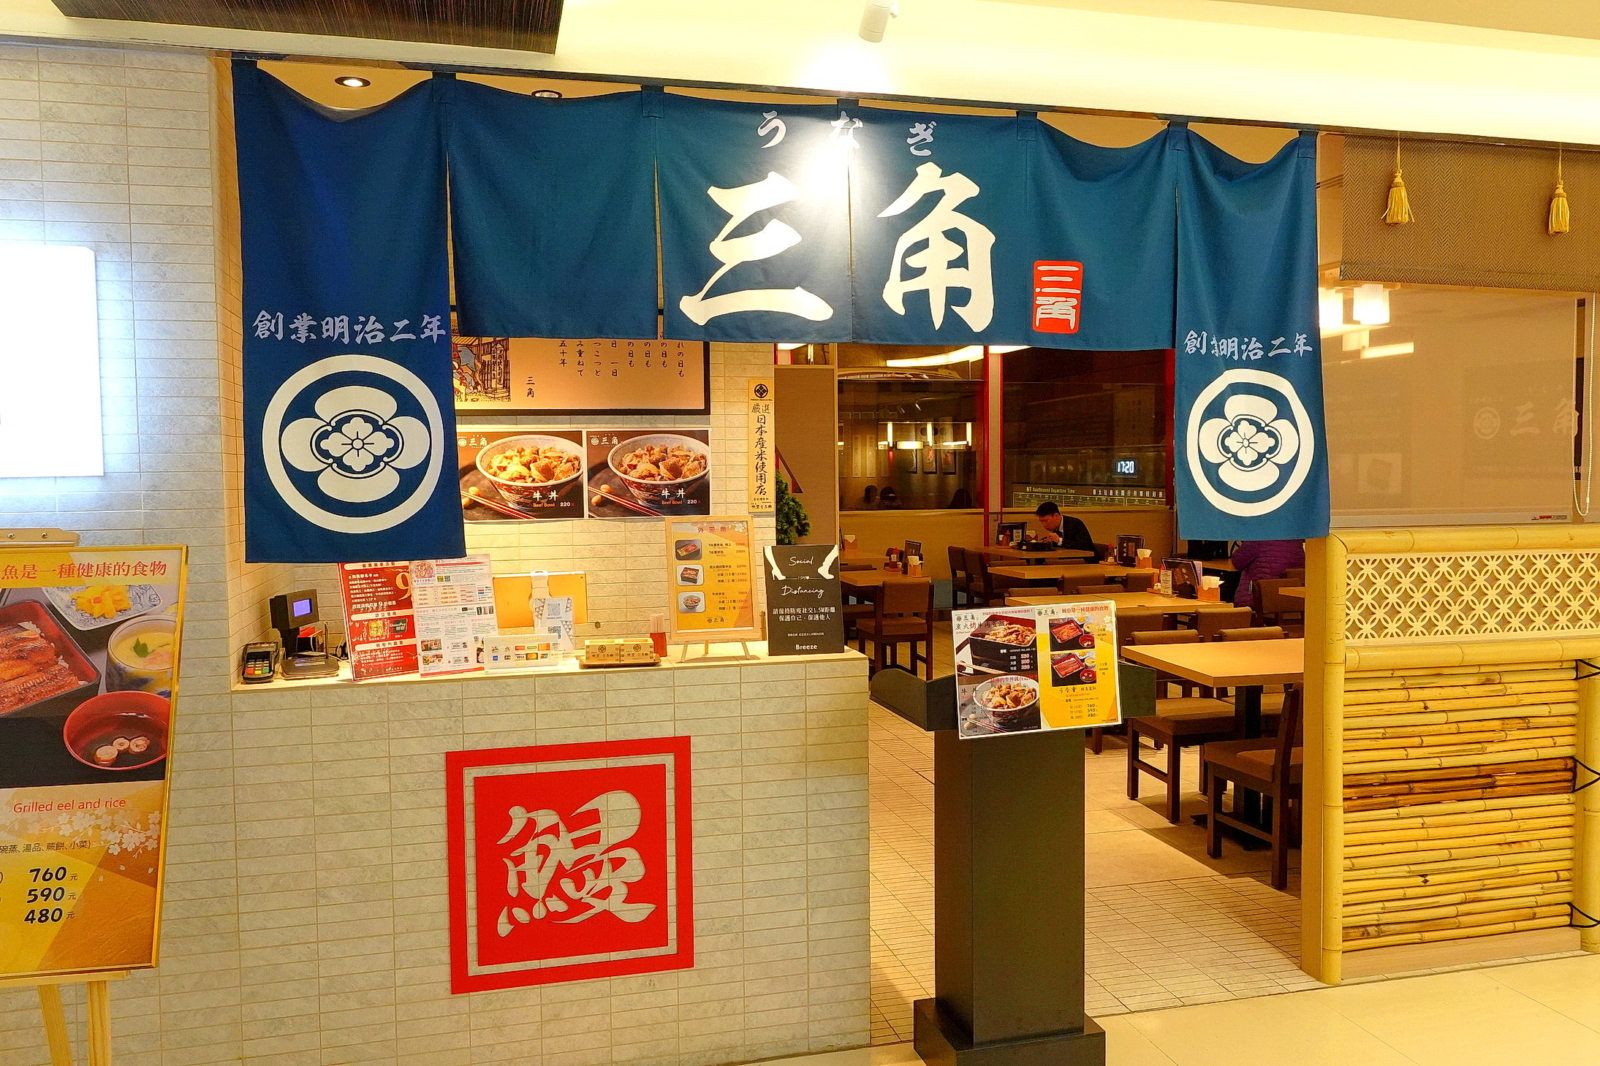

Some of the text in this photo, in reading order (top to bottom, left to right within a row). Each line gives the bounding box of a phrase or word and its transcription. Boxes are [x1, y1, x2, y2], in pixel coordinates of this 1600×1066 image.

[756, 110, 938, 157] うなぎ
[679, 161, 997, 333] 三角
[1035, 264, 1080, 331] 三角
[252, 309, 447, 344] 創業明治二年
[525, 376, 536, 398] 三角
[532, 489, 558, 501] 牛丼
[661, 487, 686, 499] 牛丼
[788, 556, 814, 567] Social
[1, 561, 167, 580] 魚是一種健康的食物
[781, 584, 825, 599] Distancing
[13, 798, 126, 813] Grilled eel and rice
[496, 789, 658, 938] 鰻
[29, 867, 67, 882] 760
[27, 887, 65, 904] 590
[24, 908, 63, 924] 480
